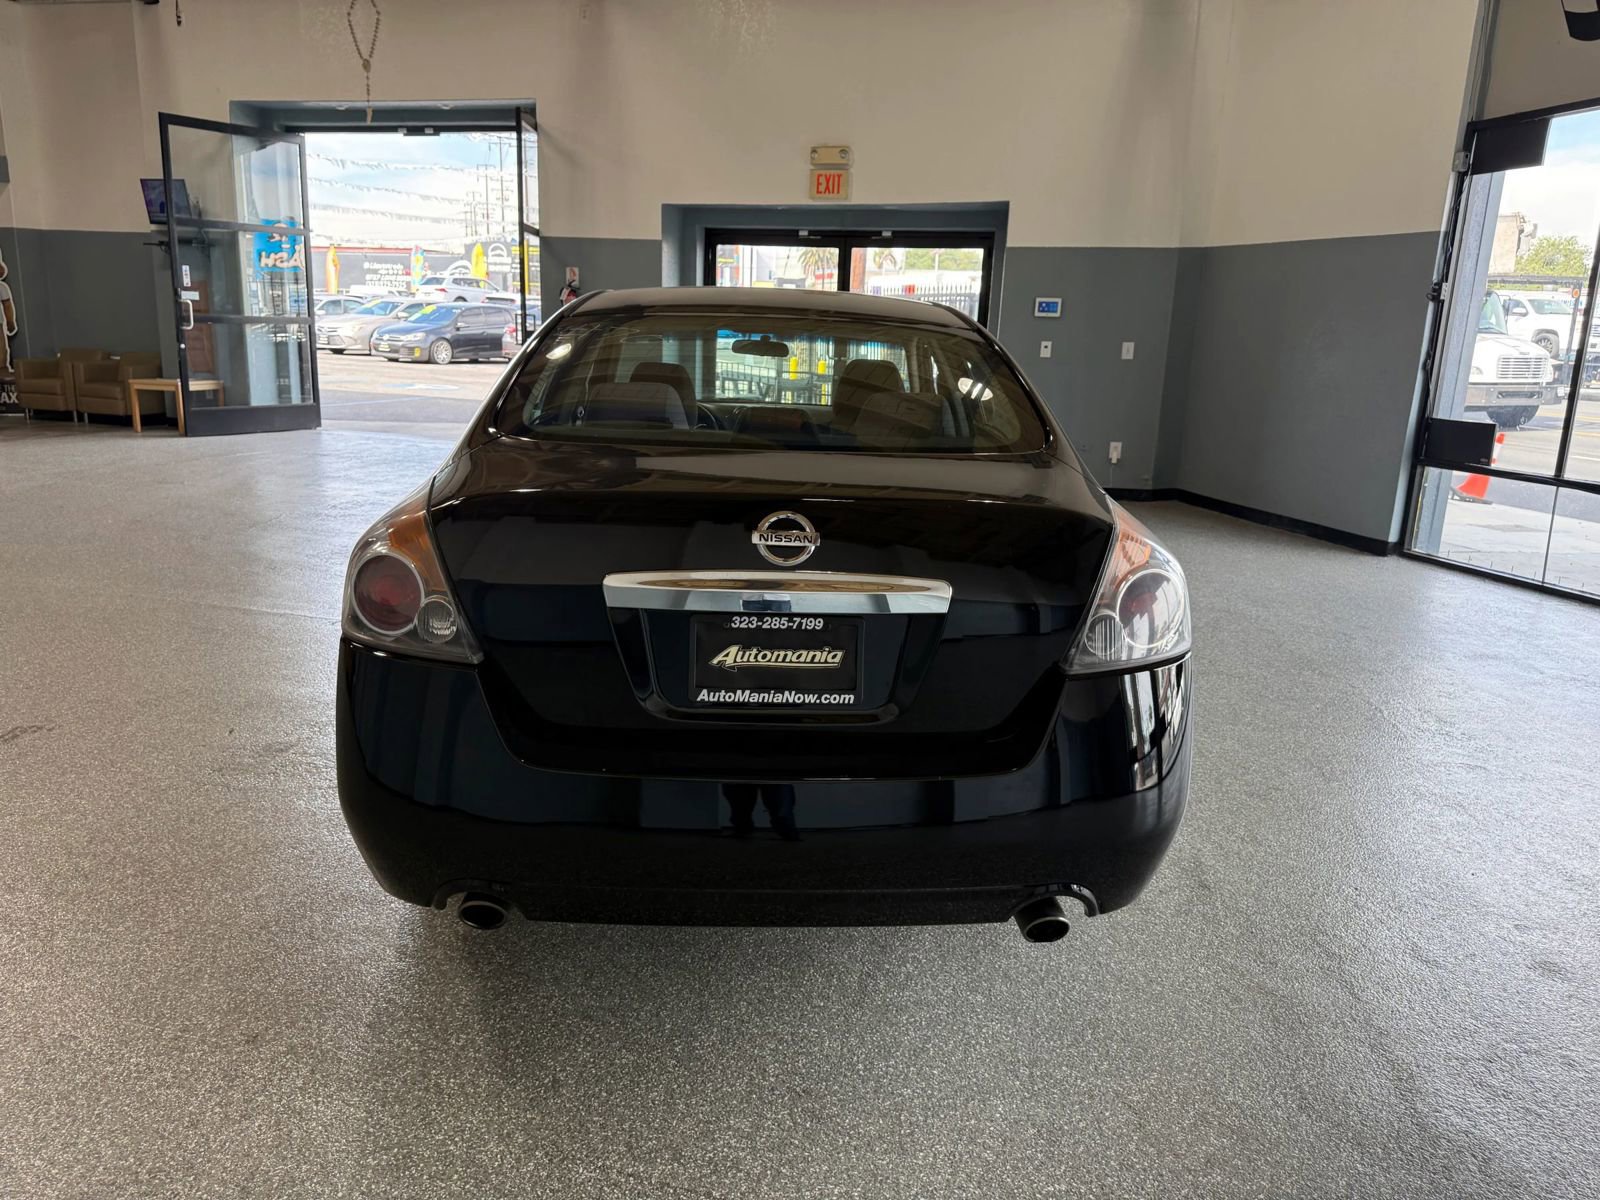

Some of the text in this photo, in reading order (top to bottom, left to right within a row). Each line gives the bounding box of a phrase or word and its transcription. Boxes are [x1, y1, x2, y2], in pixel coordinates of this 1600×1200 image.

[816, 173, 842, 194] EXIT
[759, 533, 814, 544] NISSAN
[731, 616, 824, 630] 323-285-7199
[709, 645, 846, 670] Automania
[696, 688, 855, 704] AutoManiaNow.com
